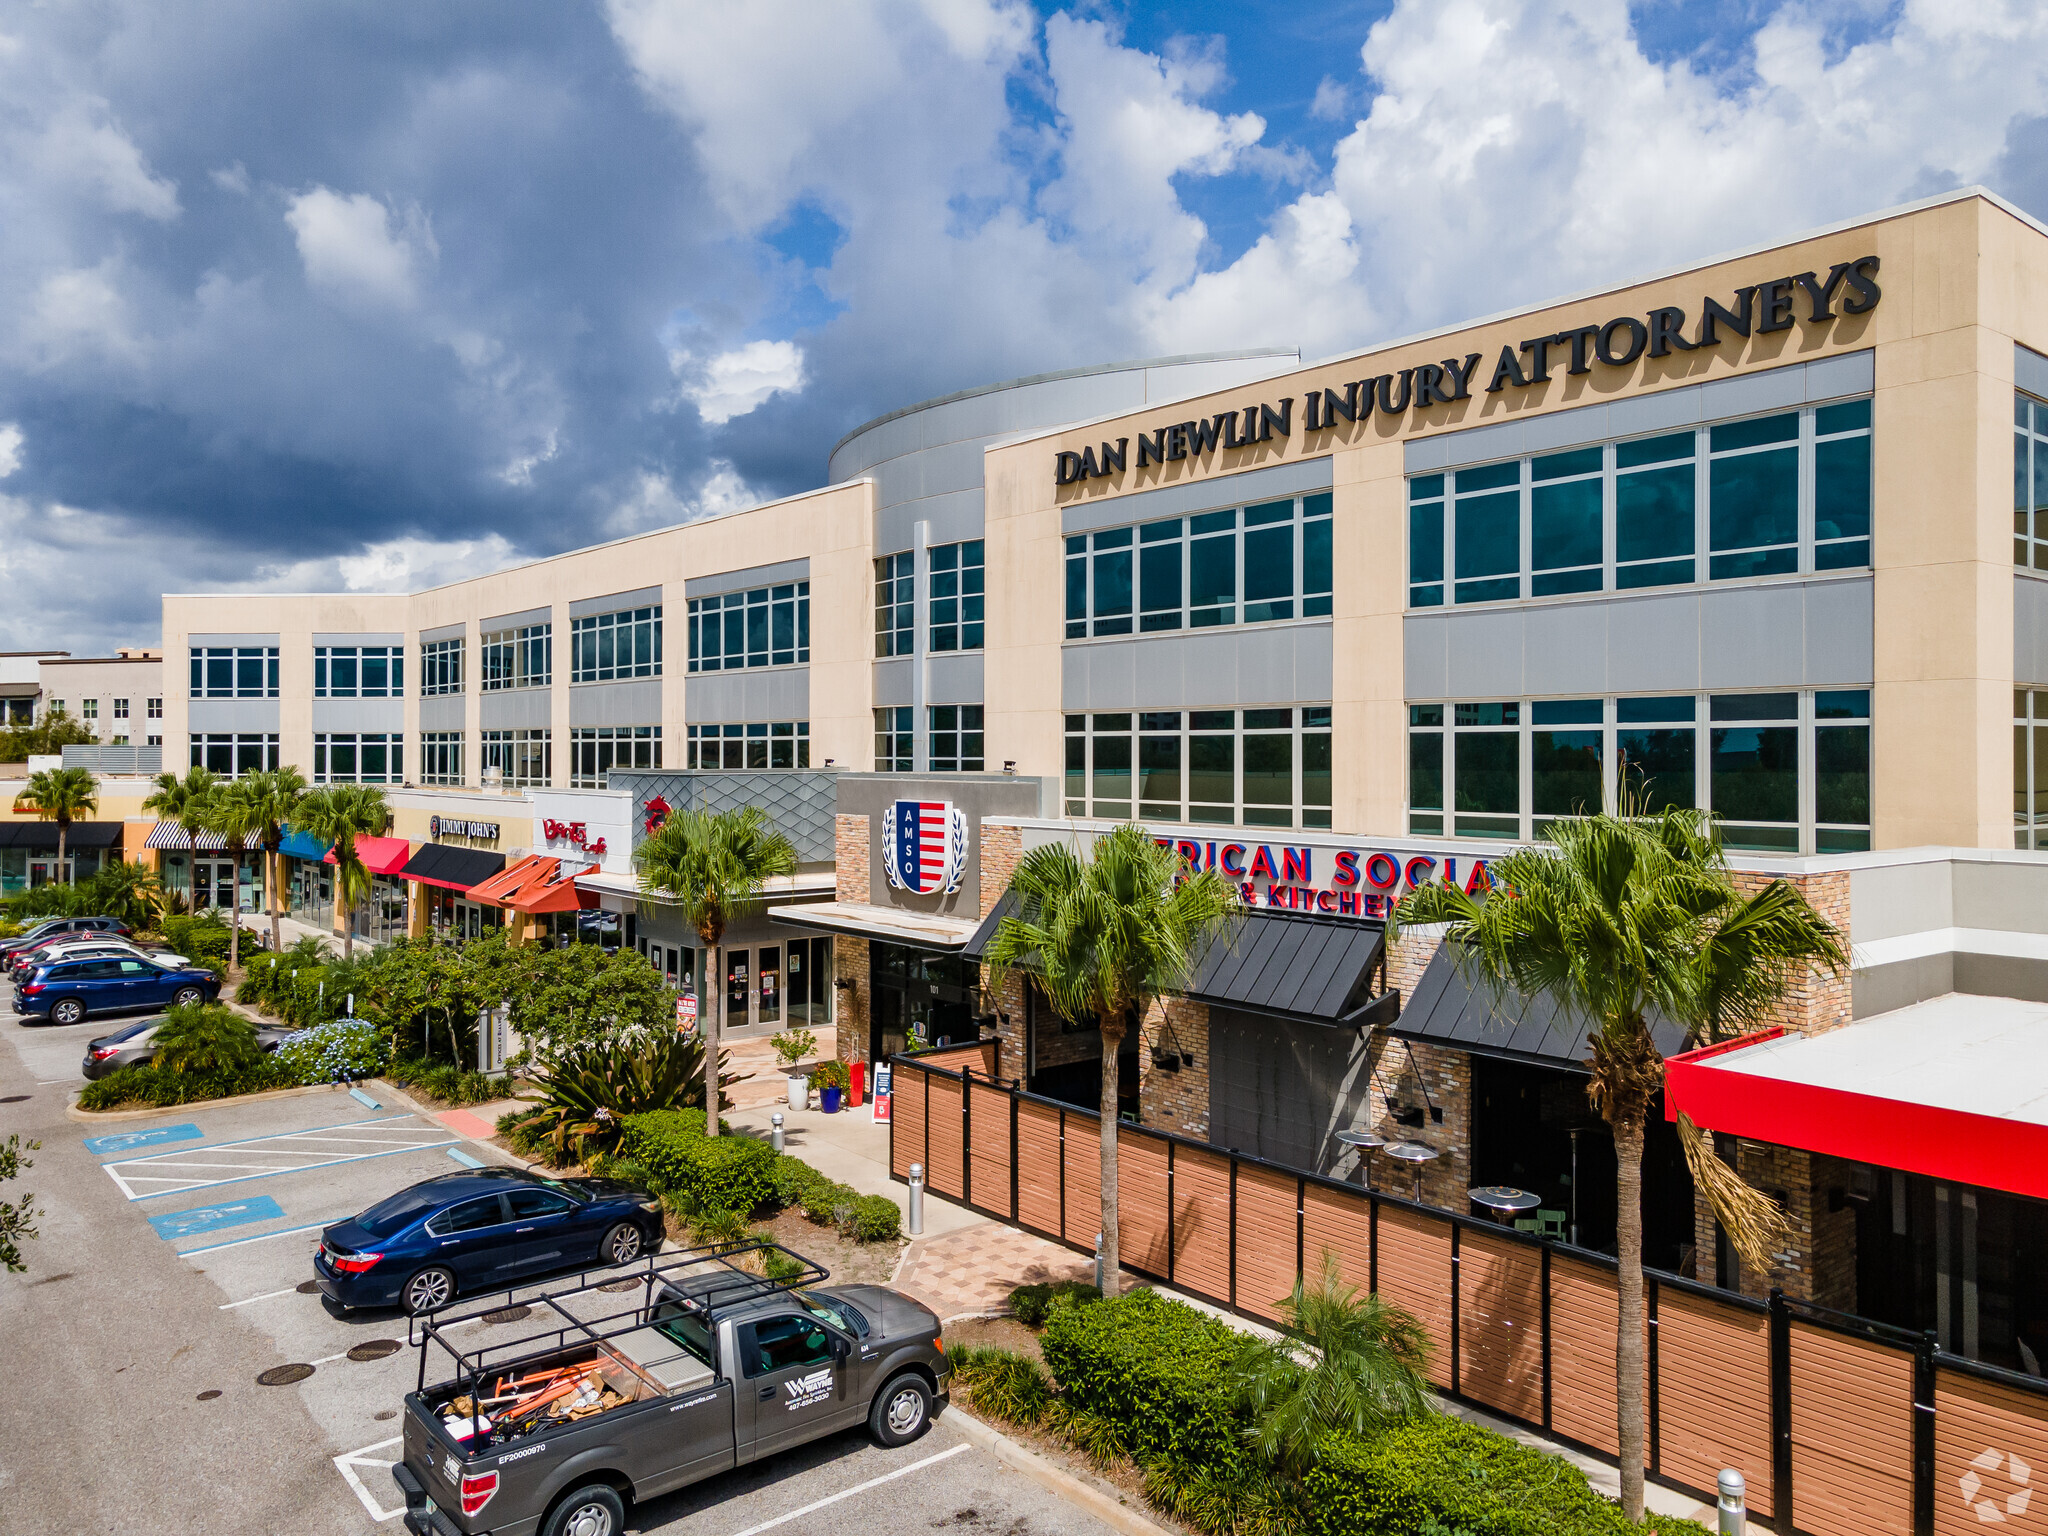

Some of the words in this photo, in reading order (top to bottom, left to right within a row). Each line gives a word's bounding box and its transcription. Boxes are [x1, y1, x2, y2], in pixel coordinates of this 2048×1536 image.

[1055, 437, 1128, 485] DAN
[1135, 397, 1294, 468] NEWLIN
[1304, 352, 1483, 432] INJURY
[1485, 255, 1881, 392] ATTORNEYS
[439, 819, 466, 836] JIMMY
[467, 821, 497, 839] JOHN'S
[904, 809, 913, 874] AMSO
[1143, 838, 1311, 882] RICAN
[1333, 850, 1521, 899] SOCIA
[929, 984, 939, 995] 101
[805, 1376, 833, 1393] WAYNE
[498, 1443, 546, 1465] EF20000970
